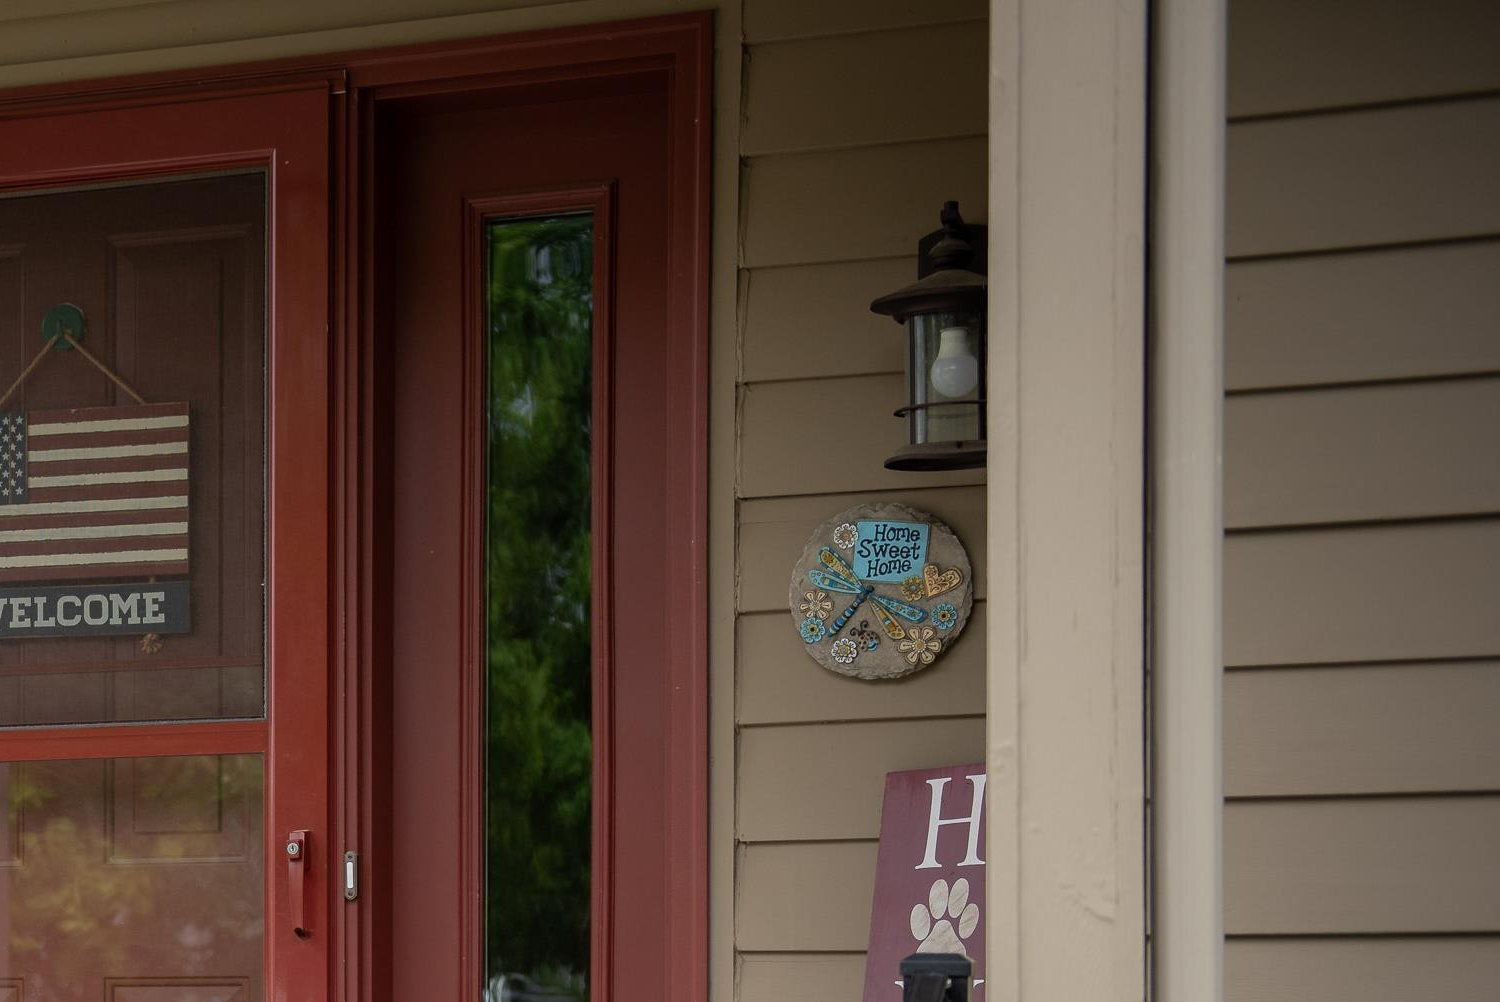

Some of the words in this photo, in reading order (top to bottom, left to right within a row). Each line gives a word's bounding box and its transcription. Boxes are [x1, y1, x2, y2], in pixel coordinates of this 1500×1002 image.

[874, 524, 920, 543] Home
[857, 539, 920, 559] Sweet
[866, 559, 912, 577] Home
